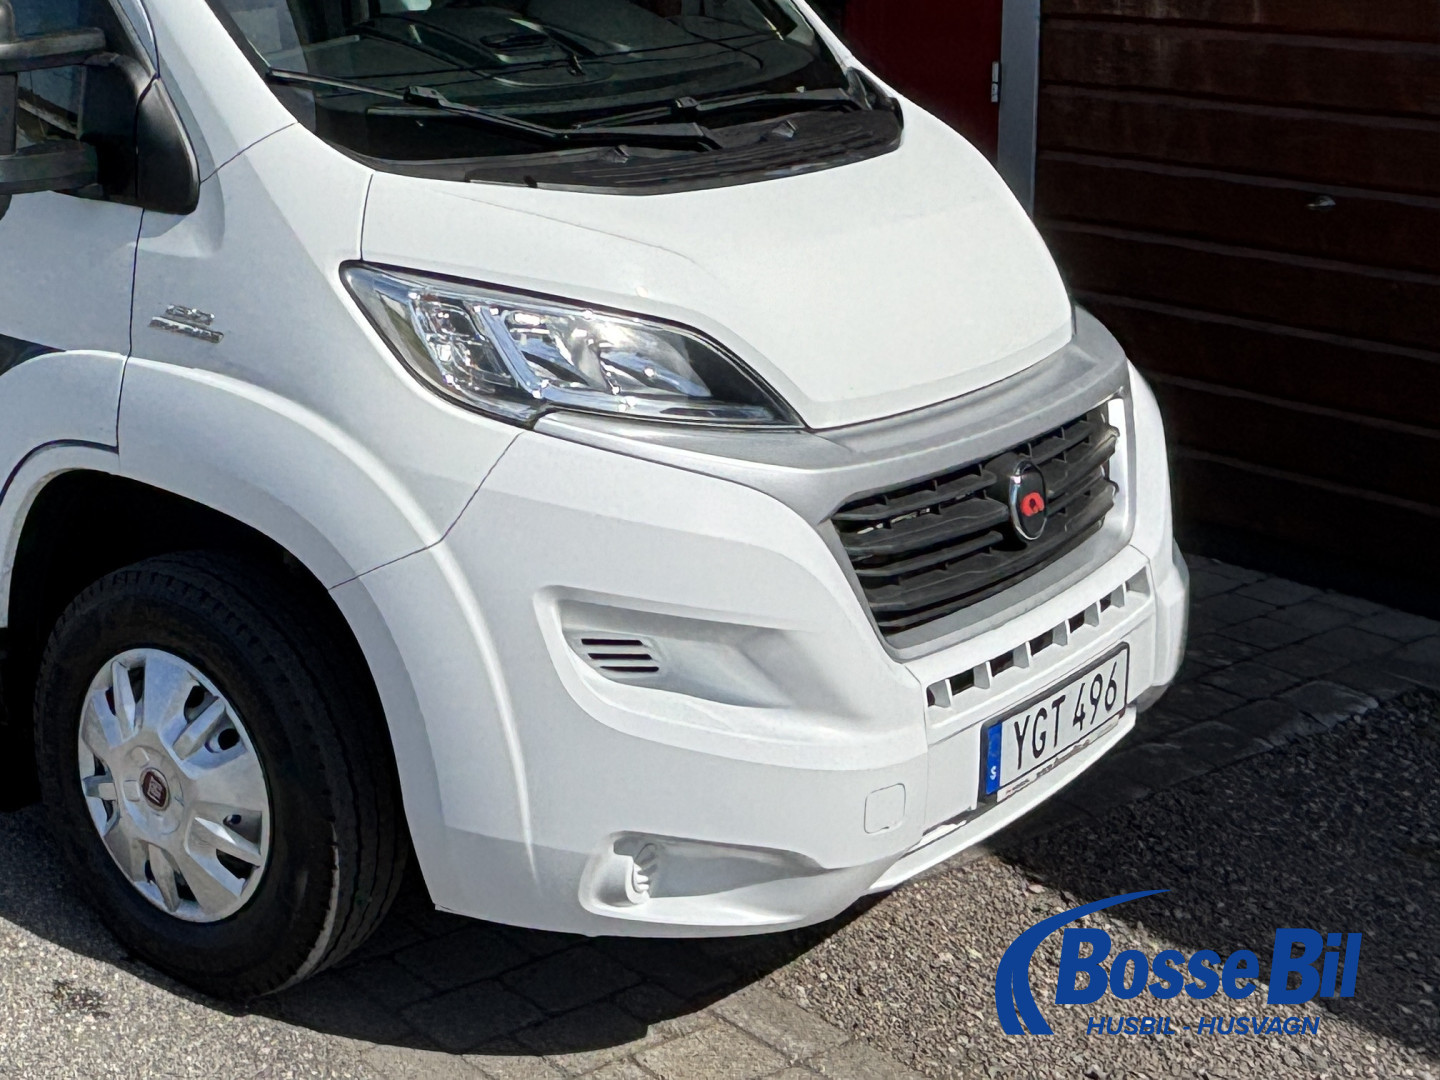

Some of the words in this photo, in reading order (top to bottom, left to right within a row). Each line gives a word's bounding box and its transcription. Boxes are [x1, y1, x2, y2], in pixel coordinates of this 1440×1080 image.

[1013, 694, 1067, 770] YGT
[1072, 661, 1118, 731] 496
[989, 765, 997, 781] S
